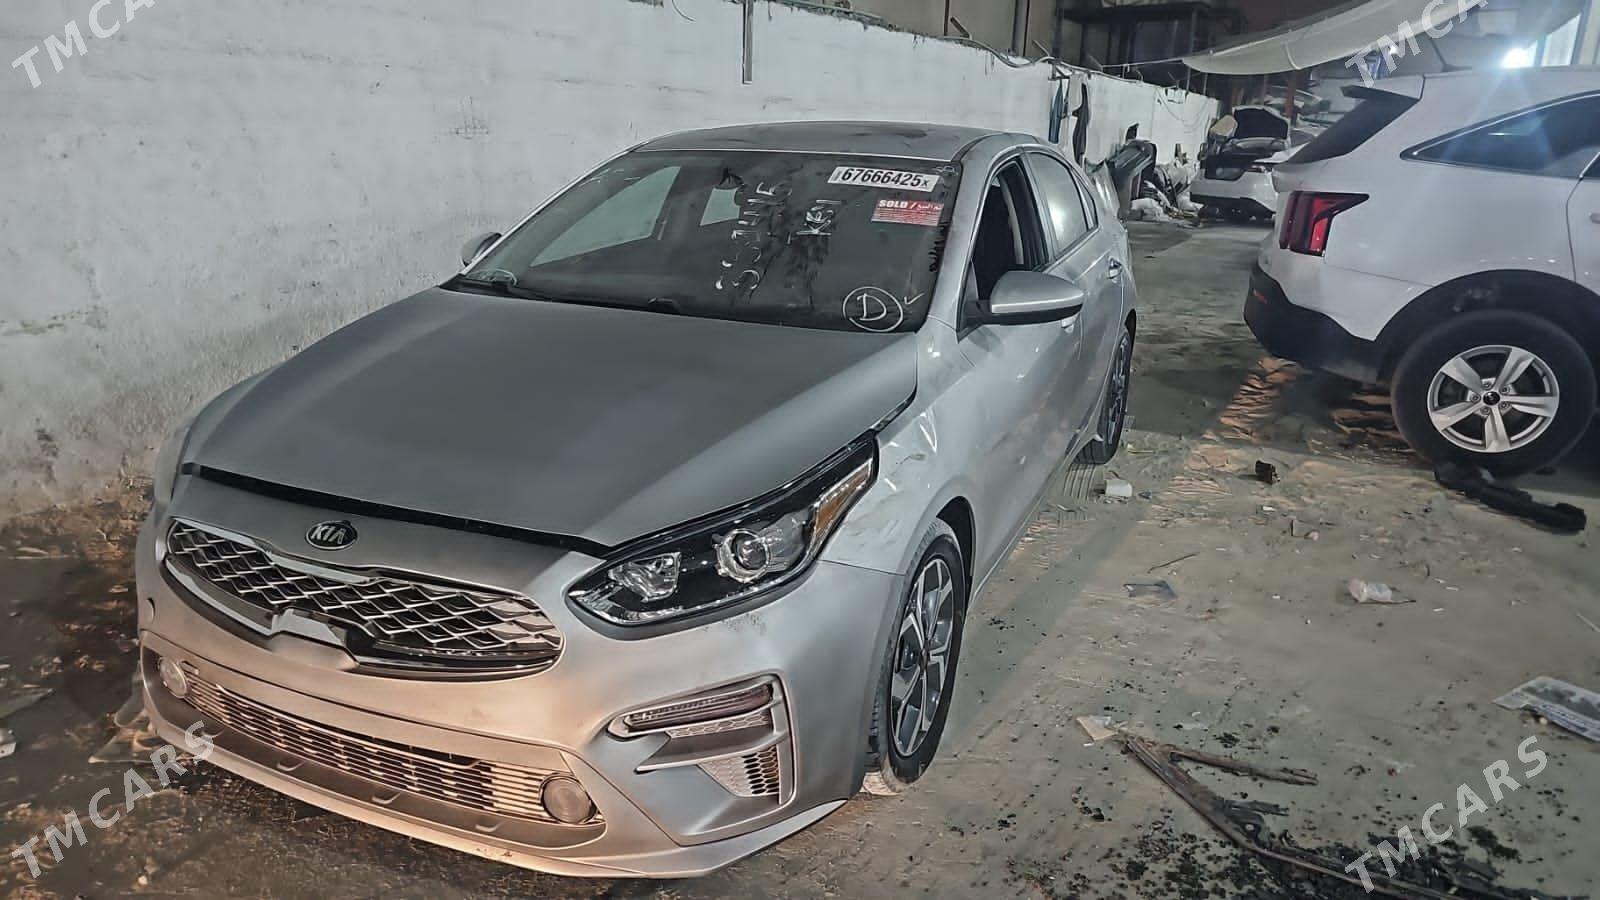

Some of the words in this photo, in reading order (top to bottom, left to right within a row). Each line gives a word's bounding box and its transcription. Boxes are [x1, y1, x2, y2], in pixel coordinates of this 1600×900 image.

[879, 199, 909, 210] SOLD
[857, 293, 887, 321] D
[310, 525, 347, 545] KIA
